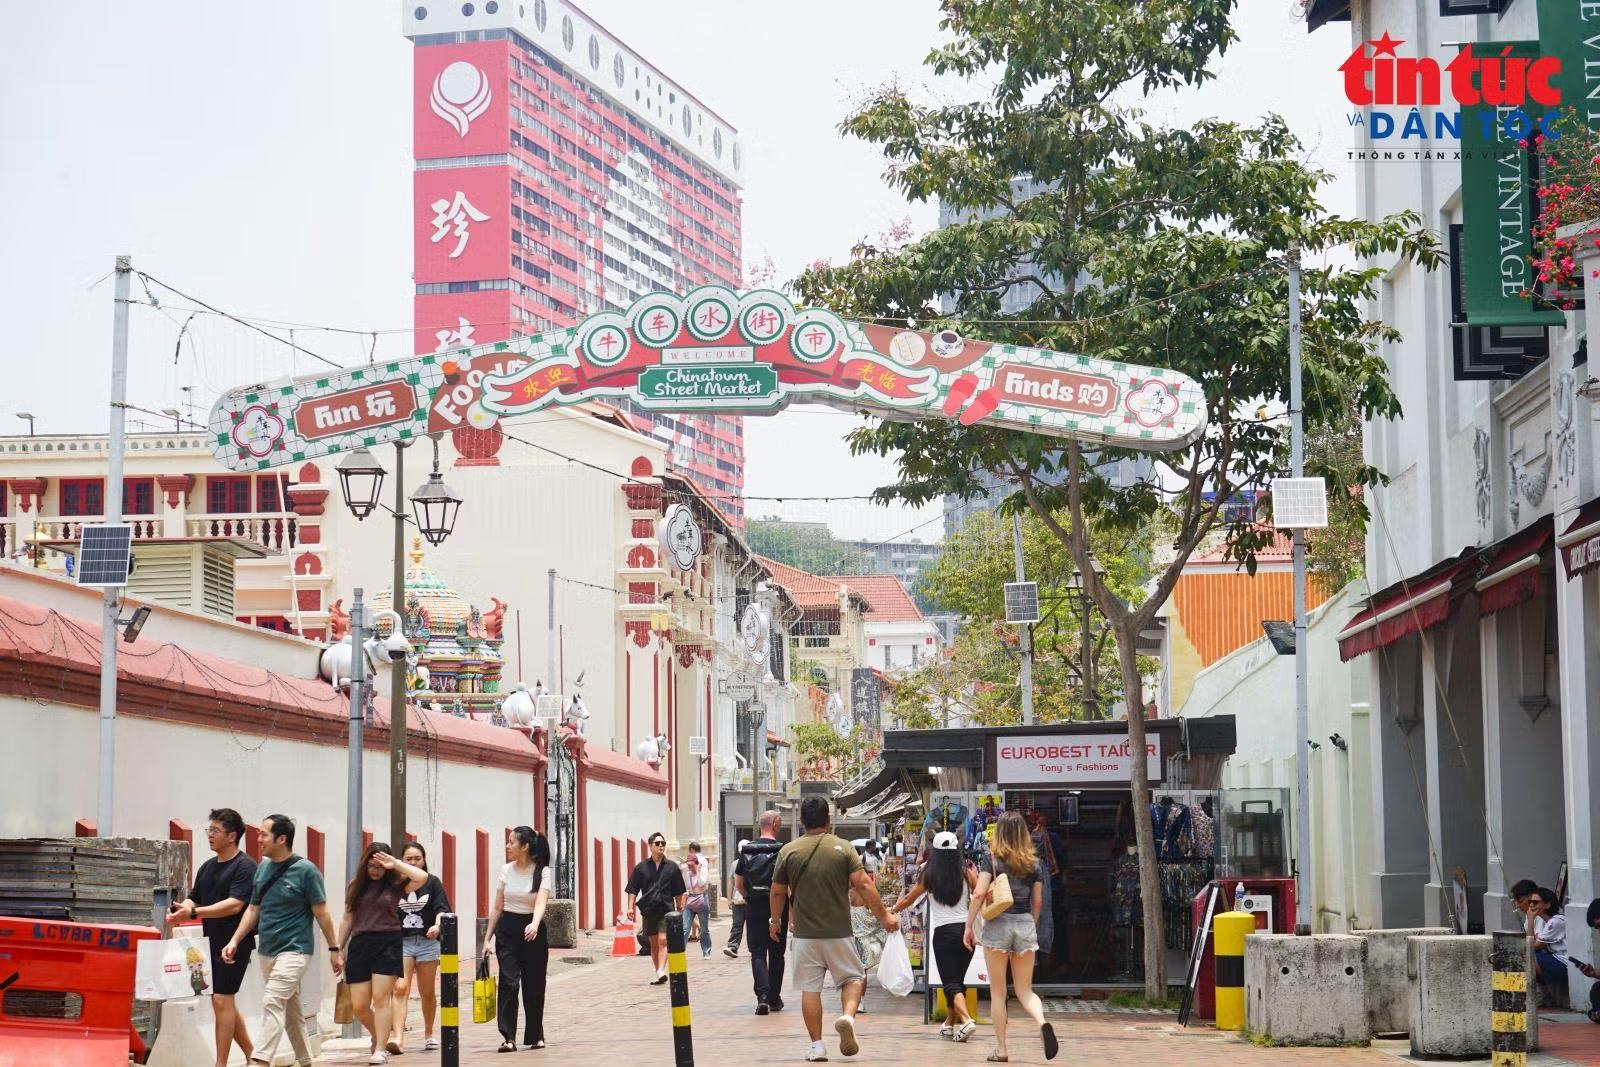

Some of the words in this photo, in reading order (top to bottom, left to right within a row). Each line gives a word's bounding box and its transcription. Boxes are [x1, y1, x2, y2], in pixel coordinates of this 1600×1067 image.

[1497, 147, 1525, 299] VINTAGE
[597, 304, 828, 356] 牛车水街市
[670, 350, 748, 360] WELCOME
[666, 368, 751, 383] Chinatown
[654, 381, 700, 396] Street
[704, 380, 763, 395] Market
[1078, 382, 1109, 407] 购
[364, 390, 396, 418] 玩
[1001, 745, 1092, 759] EUROBEST
[1097, 744, 1157, 758] TAILR
